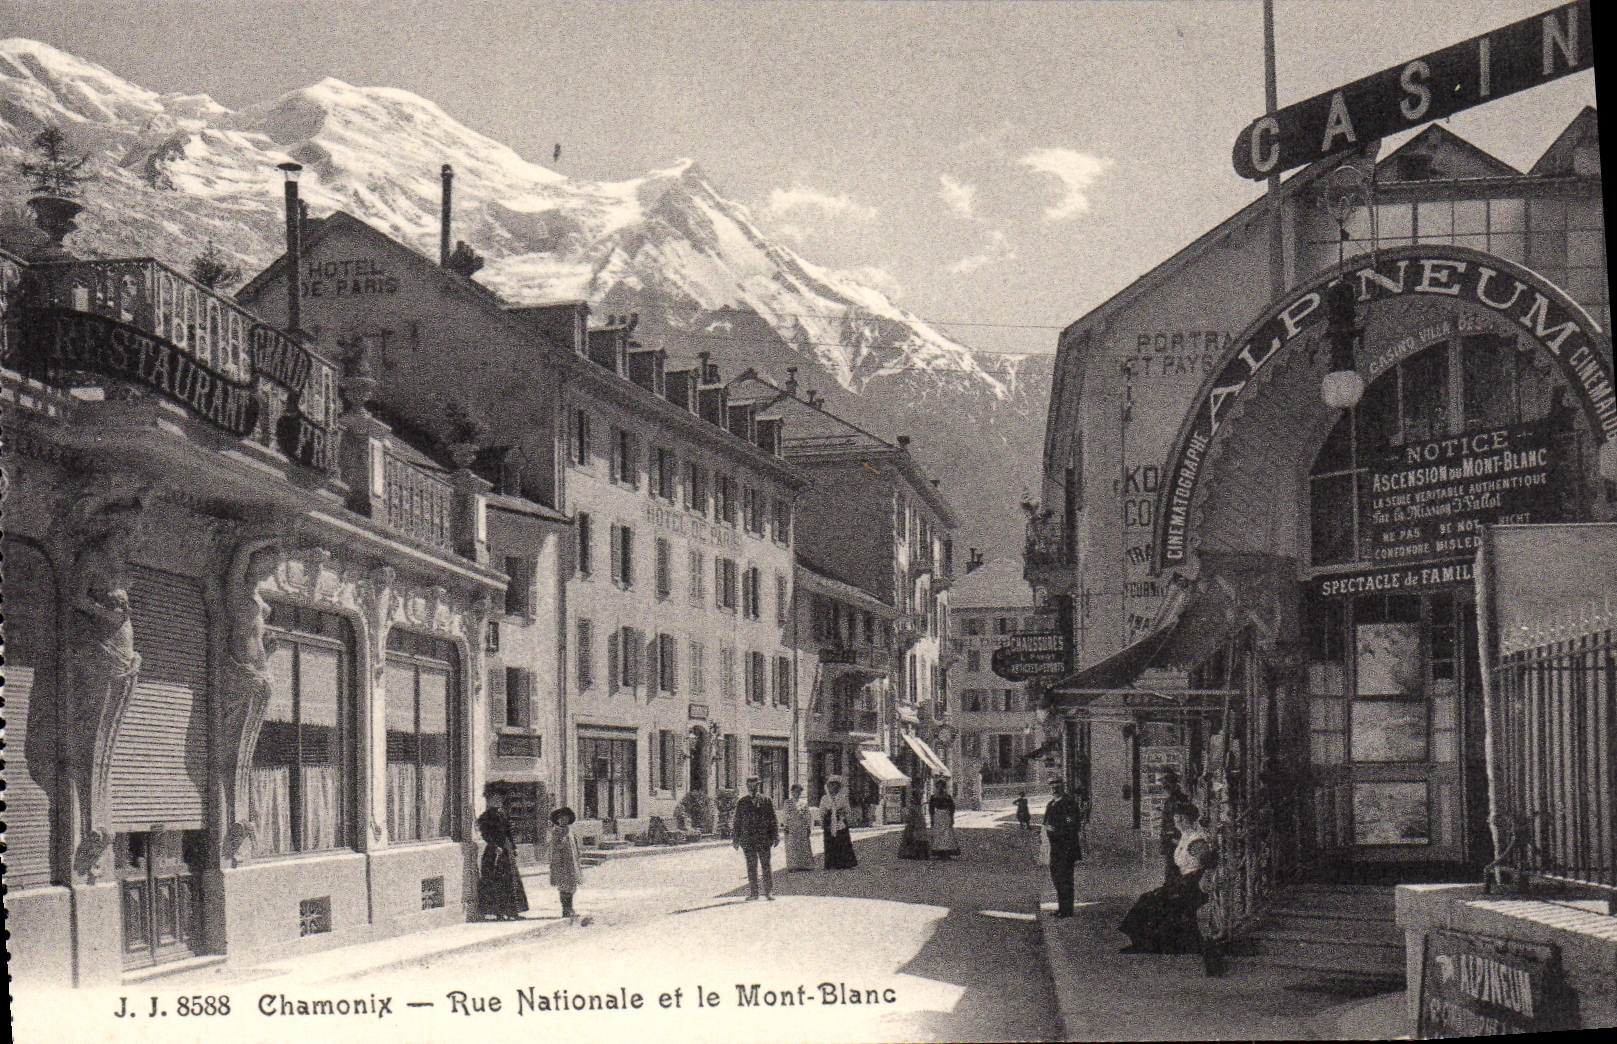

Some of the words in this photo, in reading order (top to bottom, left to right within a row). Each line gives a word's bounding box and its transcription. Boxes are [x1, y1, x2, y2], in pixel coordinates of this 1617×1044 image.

[308, 258, 384, 278] HOTEL
[337, 276, 399, 296] PARIS
[1209, 258, 1581, 436] ALPNEUM
[53, 318, 251, 432] RESTAURANT
[1406, 430, 1509, 464] NOTICE
[1372, 465, 1448, 493] ASCENSION
[1462, 447, 1548, 478] MONT-BLANC
[1167, 431, 1210, 560] CINEMATOGRAPHE
[1373, 497, 1385, 510] LA
[1469, 472, 1548, 494] AUTHENTIQUE
[1399, 527, 1421, 541] PAS
[1436, 536, 1483, 552] MISLED
[1322, 572, 1400, 596] SPECTACLE
[1420, 563, 1481, 585] FAMIL
